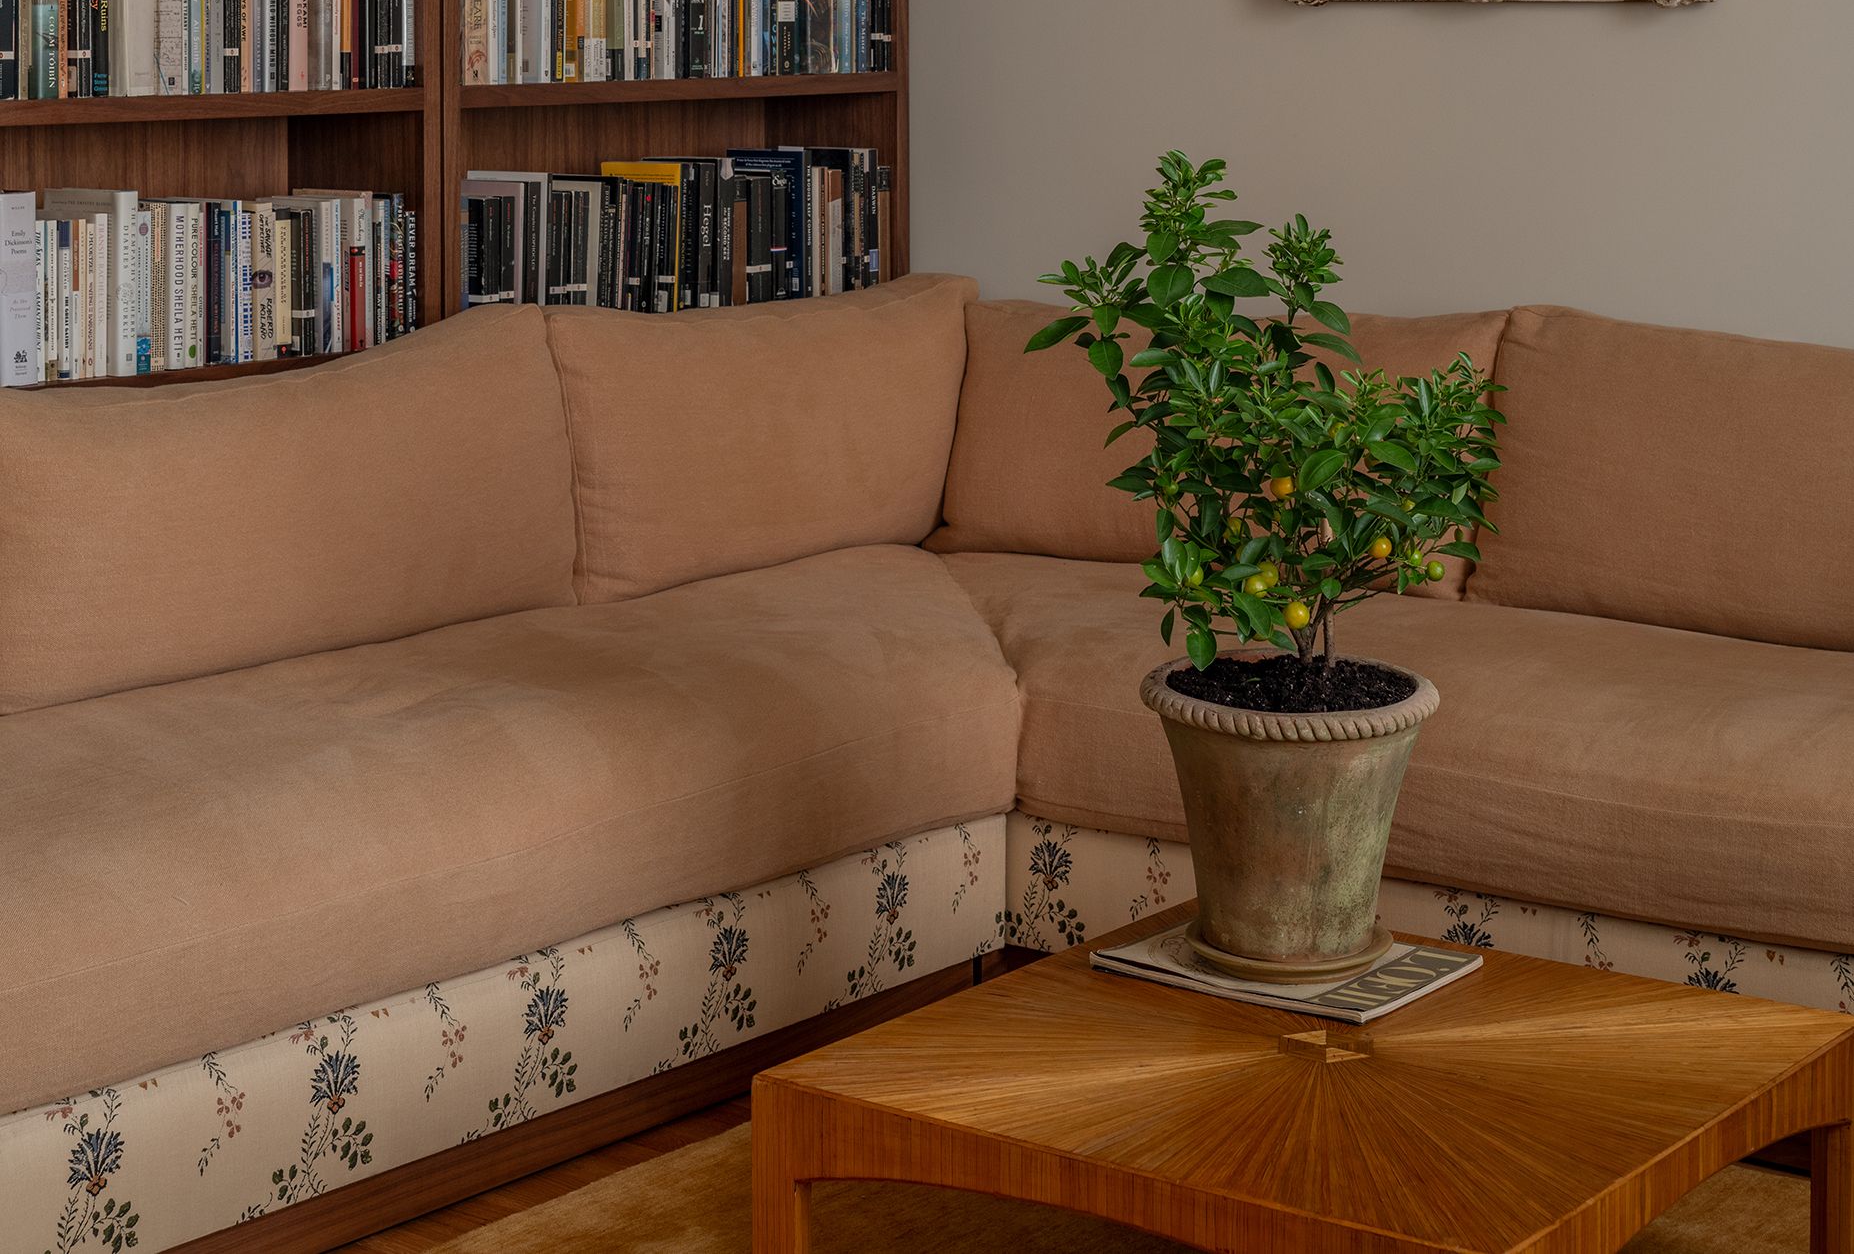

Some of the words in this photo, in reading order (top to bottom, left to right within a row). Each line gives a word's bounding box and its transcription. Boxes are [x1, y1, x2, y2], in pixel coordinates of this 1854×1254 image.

[48, 16, 56, 47] COLM
[48, 50, 57, 88] TÓIBÍN
[11, 230, 26, 238] Emily
[258, 214, 266, 254] DETECTIVES
[356, 209, 365, 242] Monkey
[408, 217, 416, 249] FEVER
[700, 204, 712, 248] Hegel
[4, 239, 33, 247] Dickinson's
[174, 215, 184, 286] MOTHERHOOD
[408, 252, 416, 287] DREAM
[174, 288, 184, 324] SHEILA
[174, 328, 183, 351] HETI
